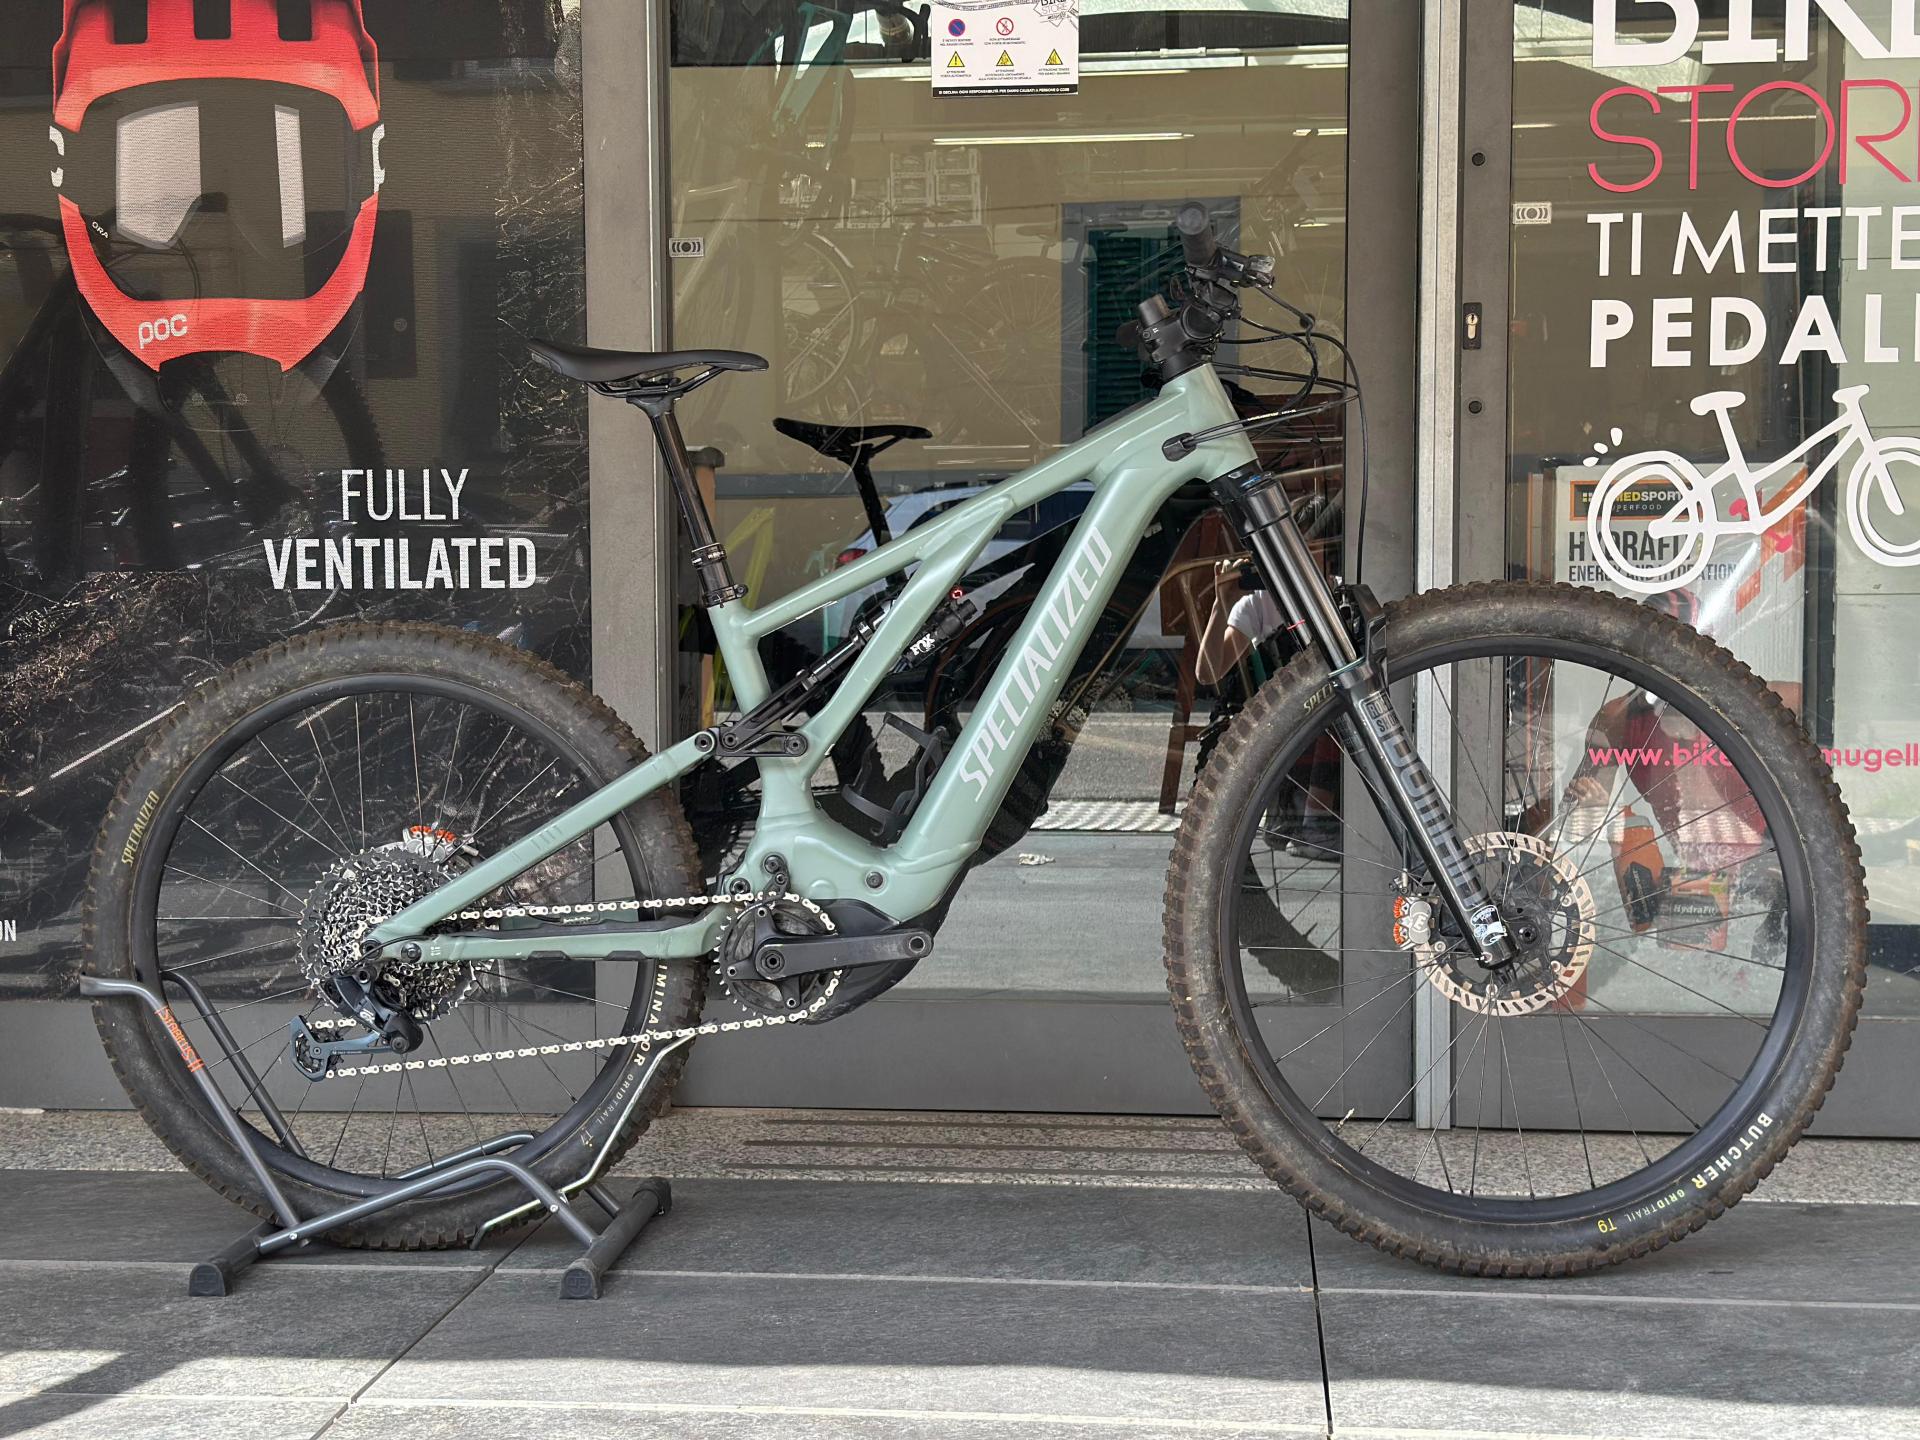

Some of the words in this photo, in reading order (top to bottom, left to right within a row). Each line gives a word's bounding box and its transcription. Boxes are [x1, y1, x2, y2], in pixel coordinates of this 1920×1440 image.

[1588, 79, 1920, 193] STOR
[91, 221, 109, 239] ORA
[1587, 212, 1643, 276] TI
[1589, 293, 1920, 368] PEDAL
[341, 468, 469, 522] FULLY
[1612, 504, 1662, 513] PERFOOD
[263, 537, 537, 591] VENTILATED
[910, 633, 935, 656] FOX
[959, 526, 1113, 802] SPECIALIZED
[121, 790, 160, 868] SPECIALIZED
[633, 963, 668, 1067] IMINATOR
[1691, 1112, 1773, 1190] BUTCHER
[1597, 1217, 1618, 1234] T9
